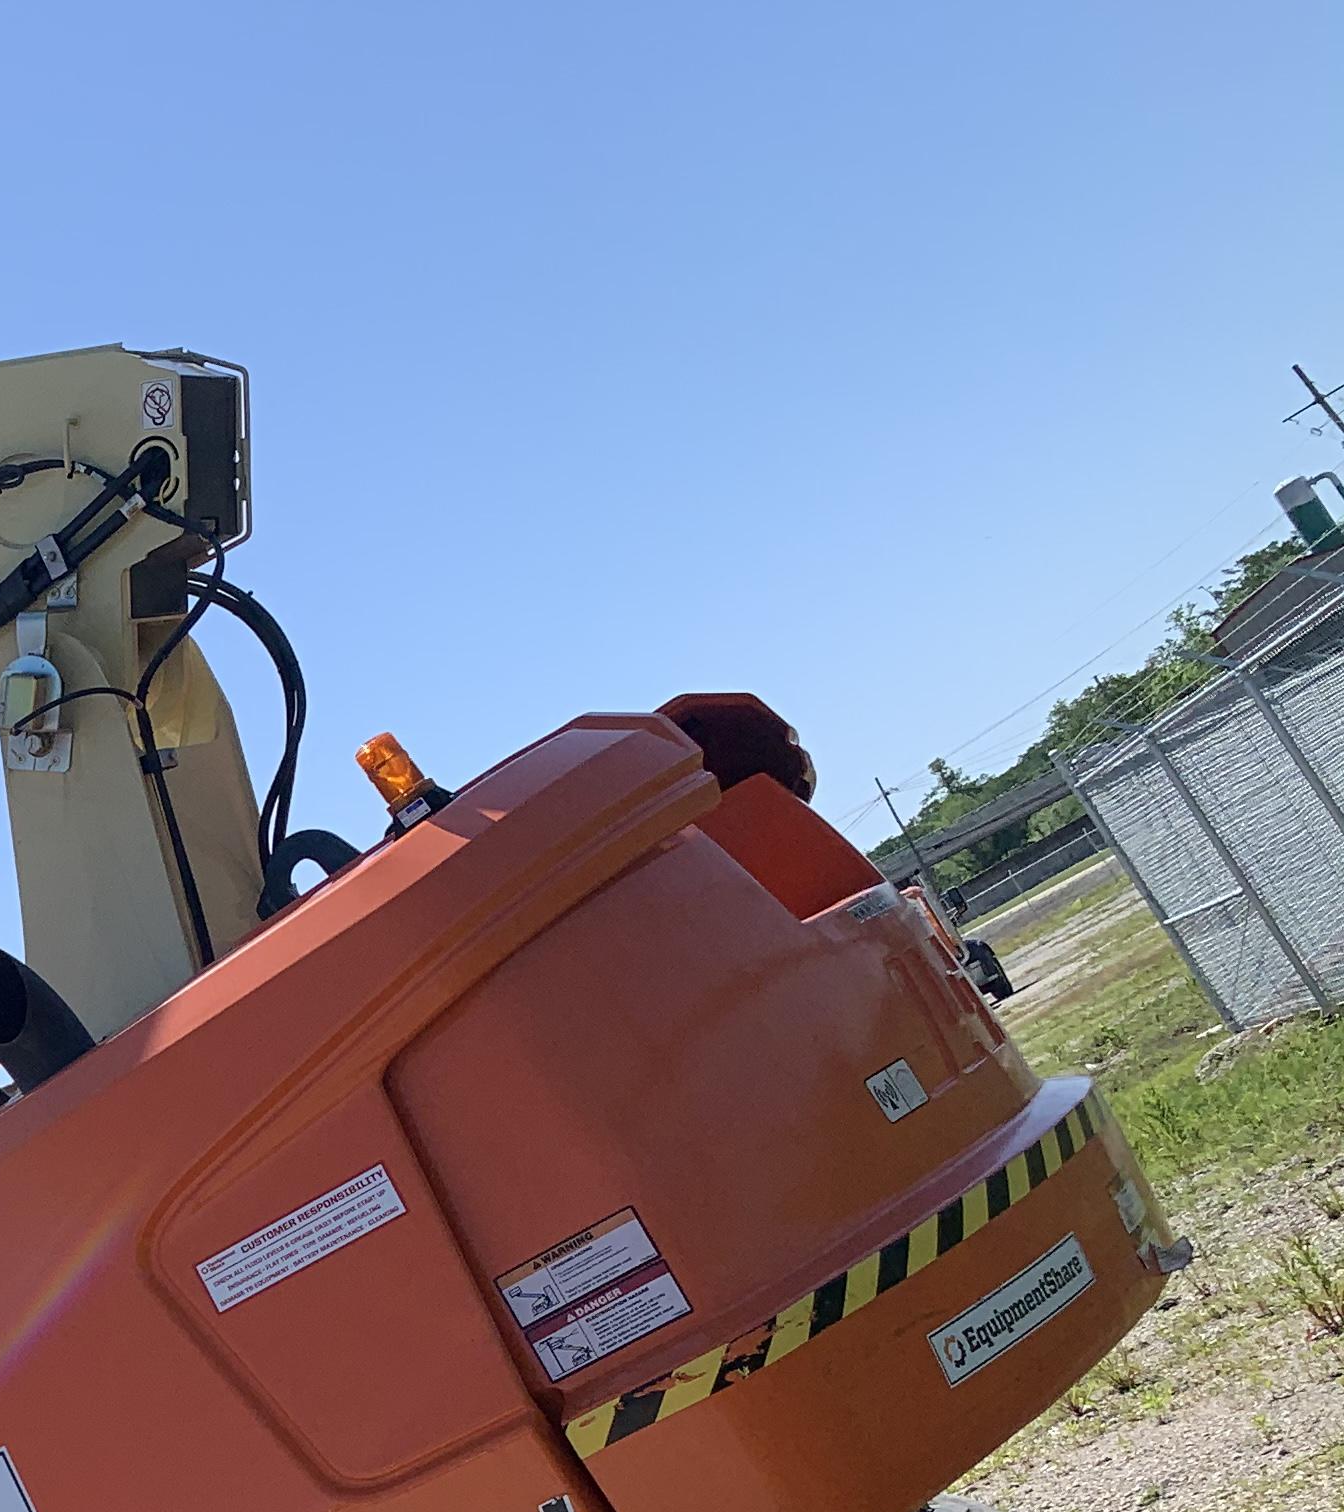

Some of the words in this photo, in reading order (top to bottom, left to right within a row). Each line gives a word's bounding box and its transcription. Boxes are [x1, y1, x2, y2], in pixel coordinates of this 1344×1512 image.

[240, 1218, 297, 1253] CUSTOMER
[296, 1169, 384, 1223] RESPONSIBILITY
[541, 1231, 594, 1264] WARNING
[574, 1287, 623, 1318] DANGER
[962, 1255, 1083, 1353] EquipmentShare
